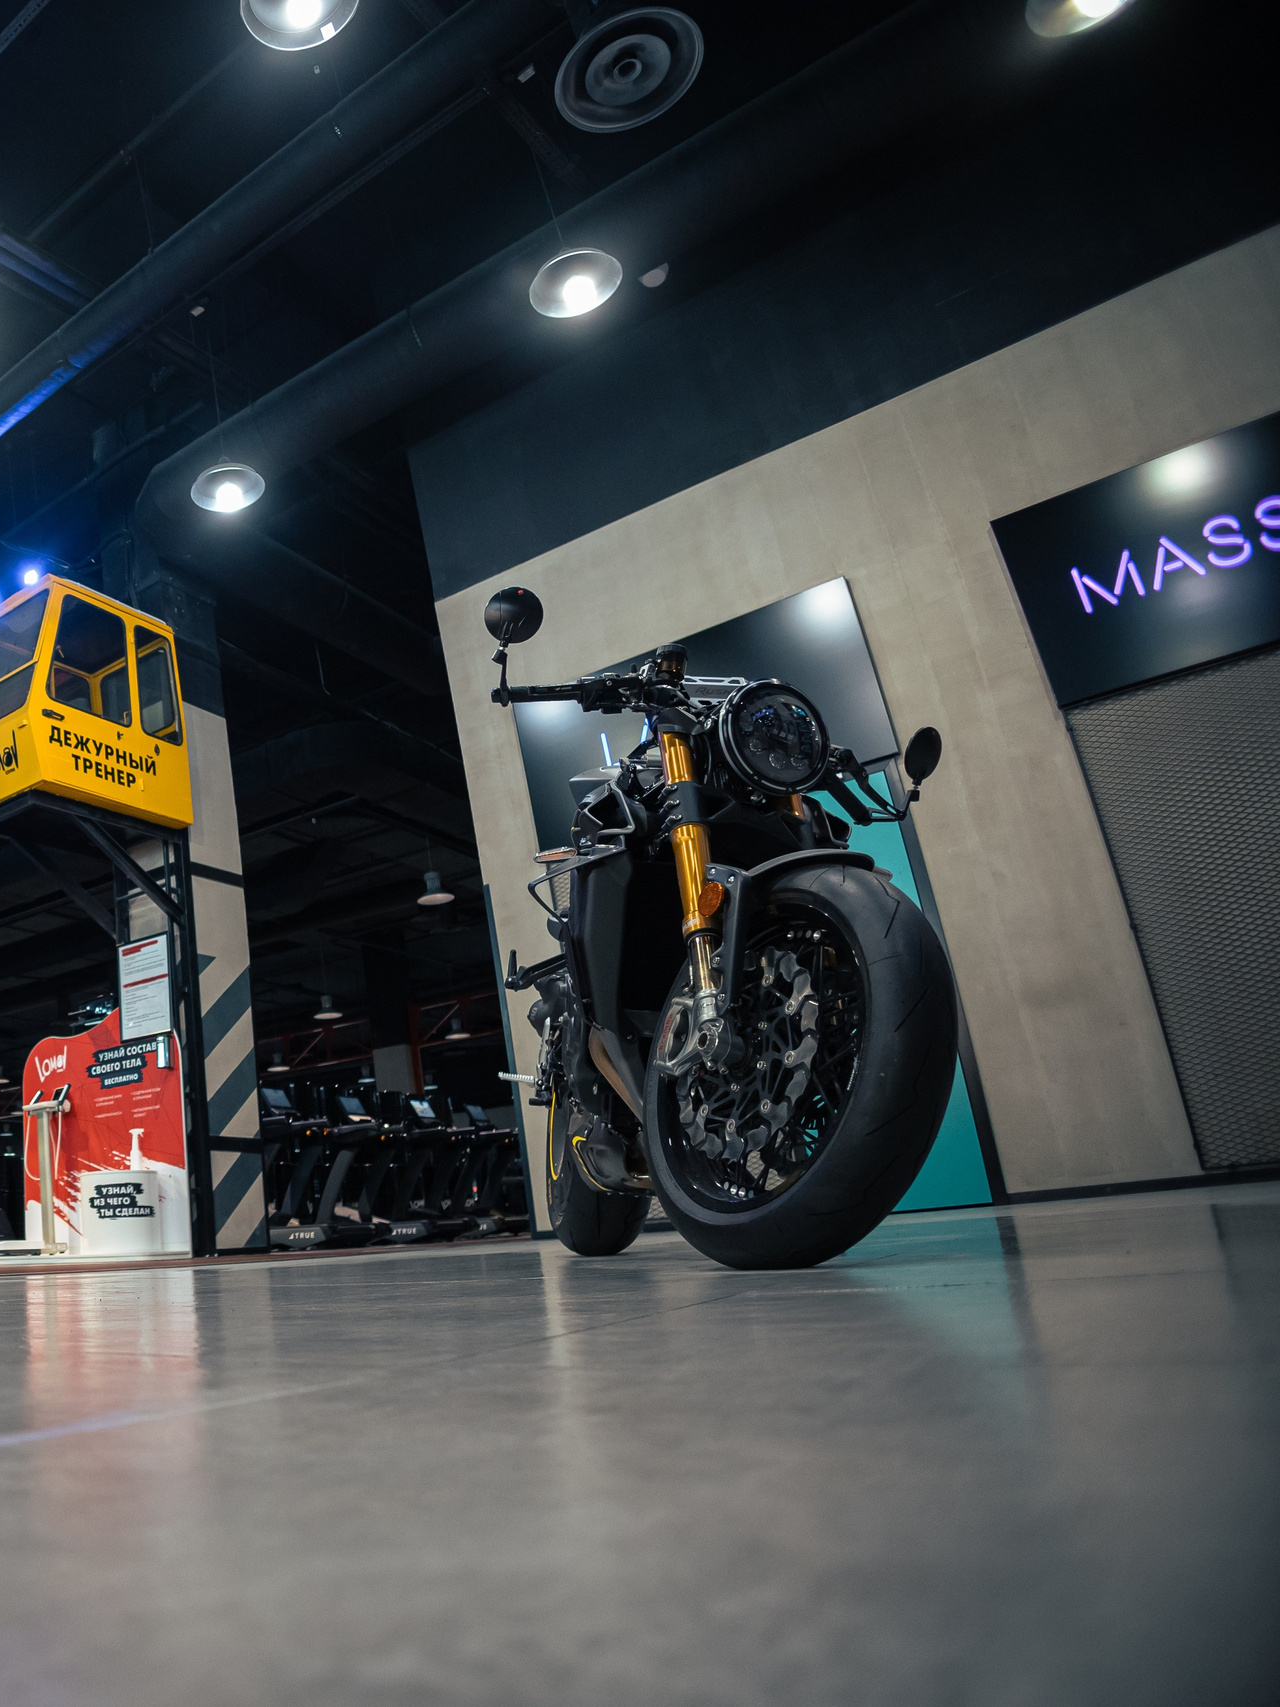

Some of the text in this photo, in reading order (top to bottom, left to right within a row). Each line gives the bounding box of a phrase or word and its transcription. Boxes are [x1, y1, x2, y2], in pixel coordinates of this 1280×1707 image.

[48, 725, 157, 776] ДЕЖУРНЫЙ
[71, 753, 136, 788] ТРЕНЕР
[98, 1041, 157, 1062] УЗНАЙ СОСТАВ
[91, 1057, 142, 1076] СВОЕГО ТЕЛА
[104, 1073, 139, 1086] БЕСПЛАТНО
[93, 1196, 131, 1207] ИЗ ЧЕГО
[100, 1207, 150, 1217] ТЫ СДЕЛАН
